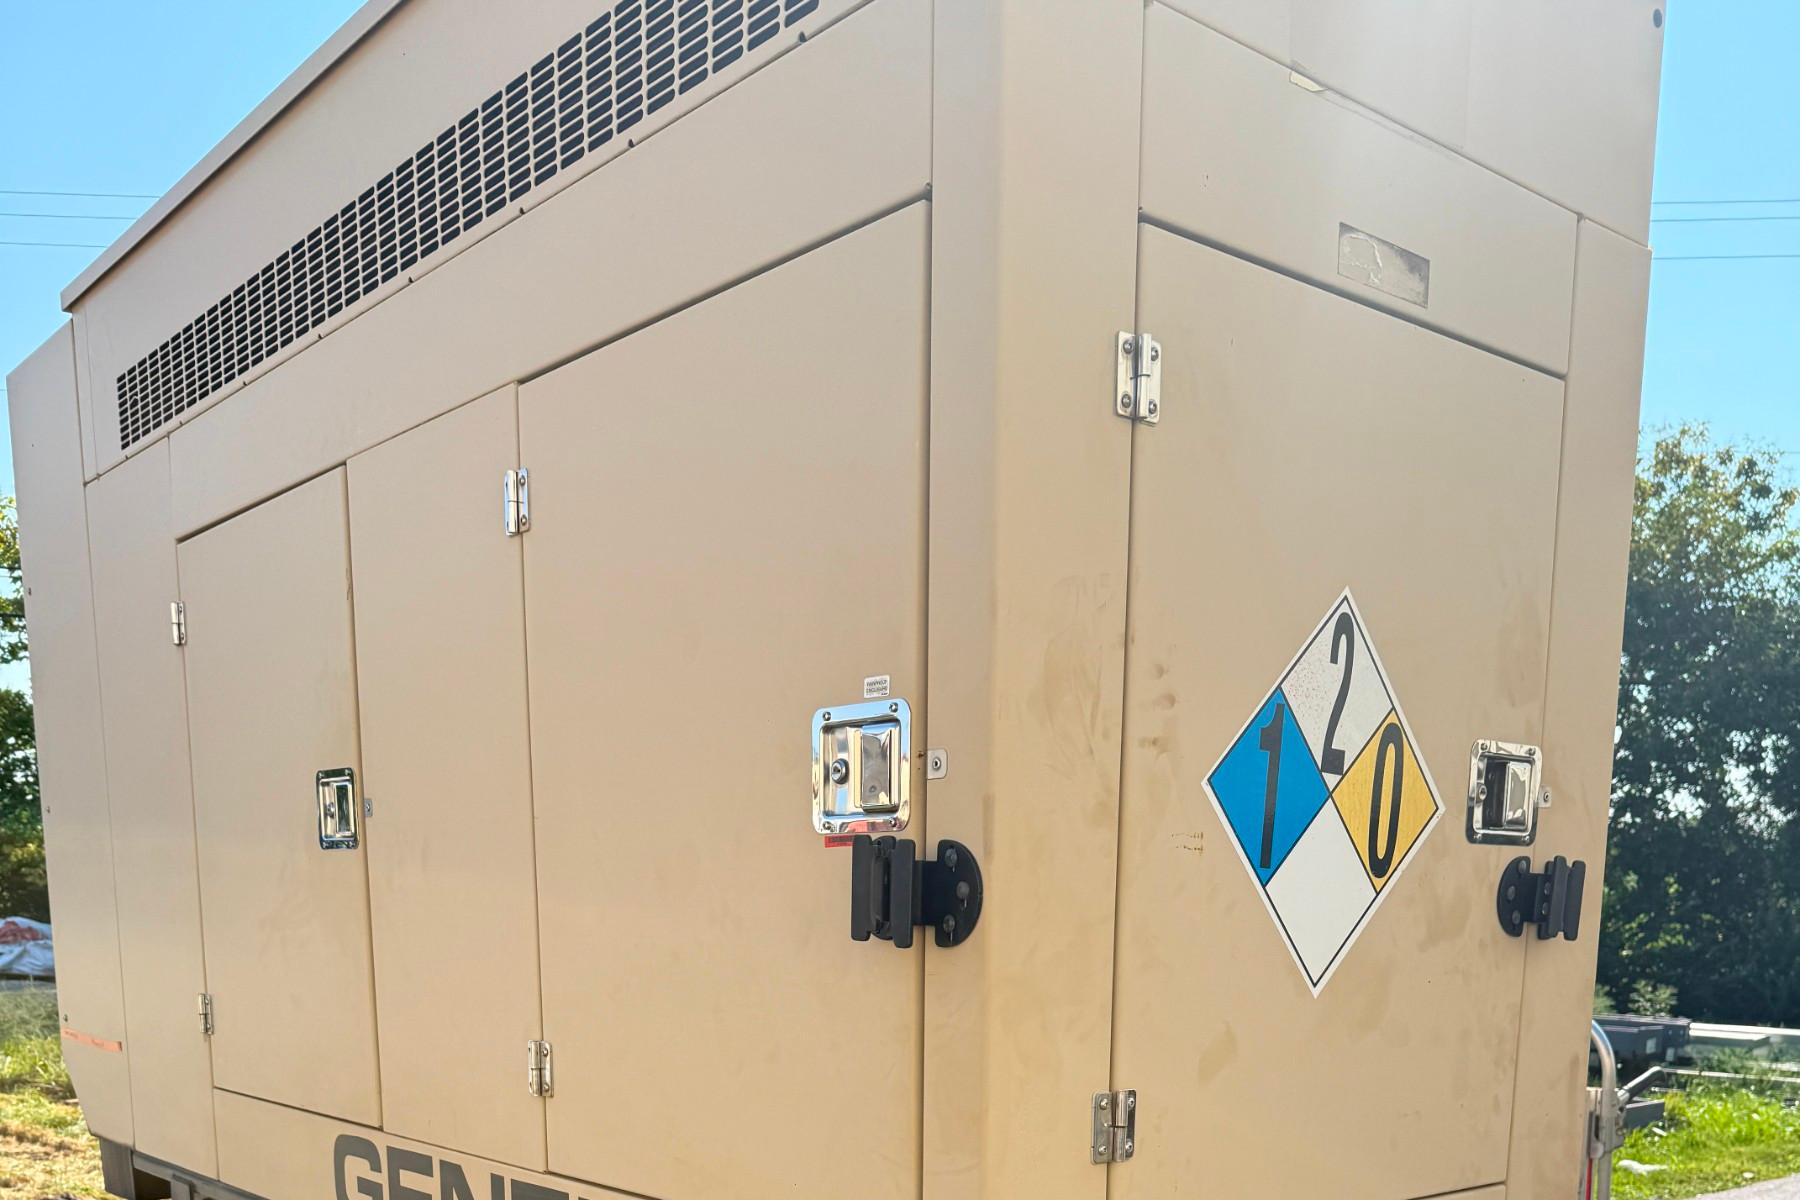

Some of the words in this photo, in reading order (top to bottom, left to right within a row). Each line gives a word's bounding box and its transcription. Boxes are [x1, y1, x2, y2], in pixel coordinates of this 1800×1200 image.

[1320, 611, 1355, 776] 2
[1259, 703, 1286, 869] 1
[1367, 722, 1404, 879] 0
